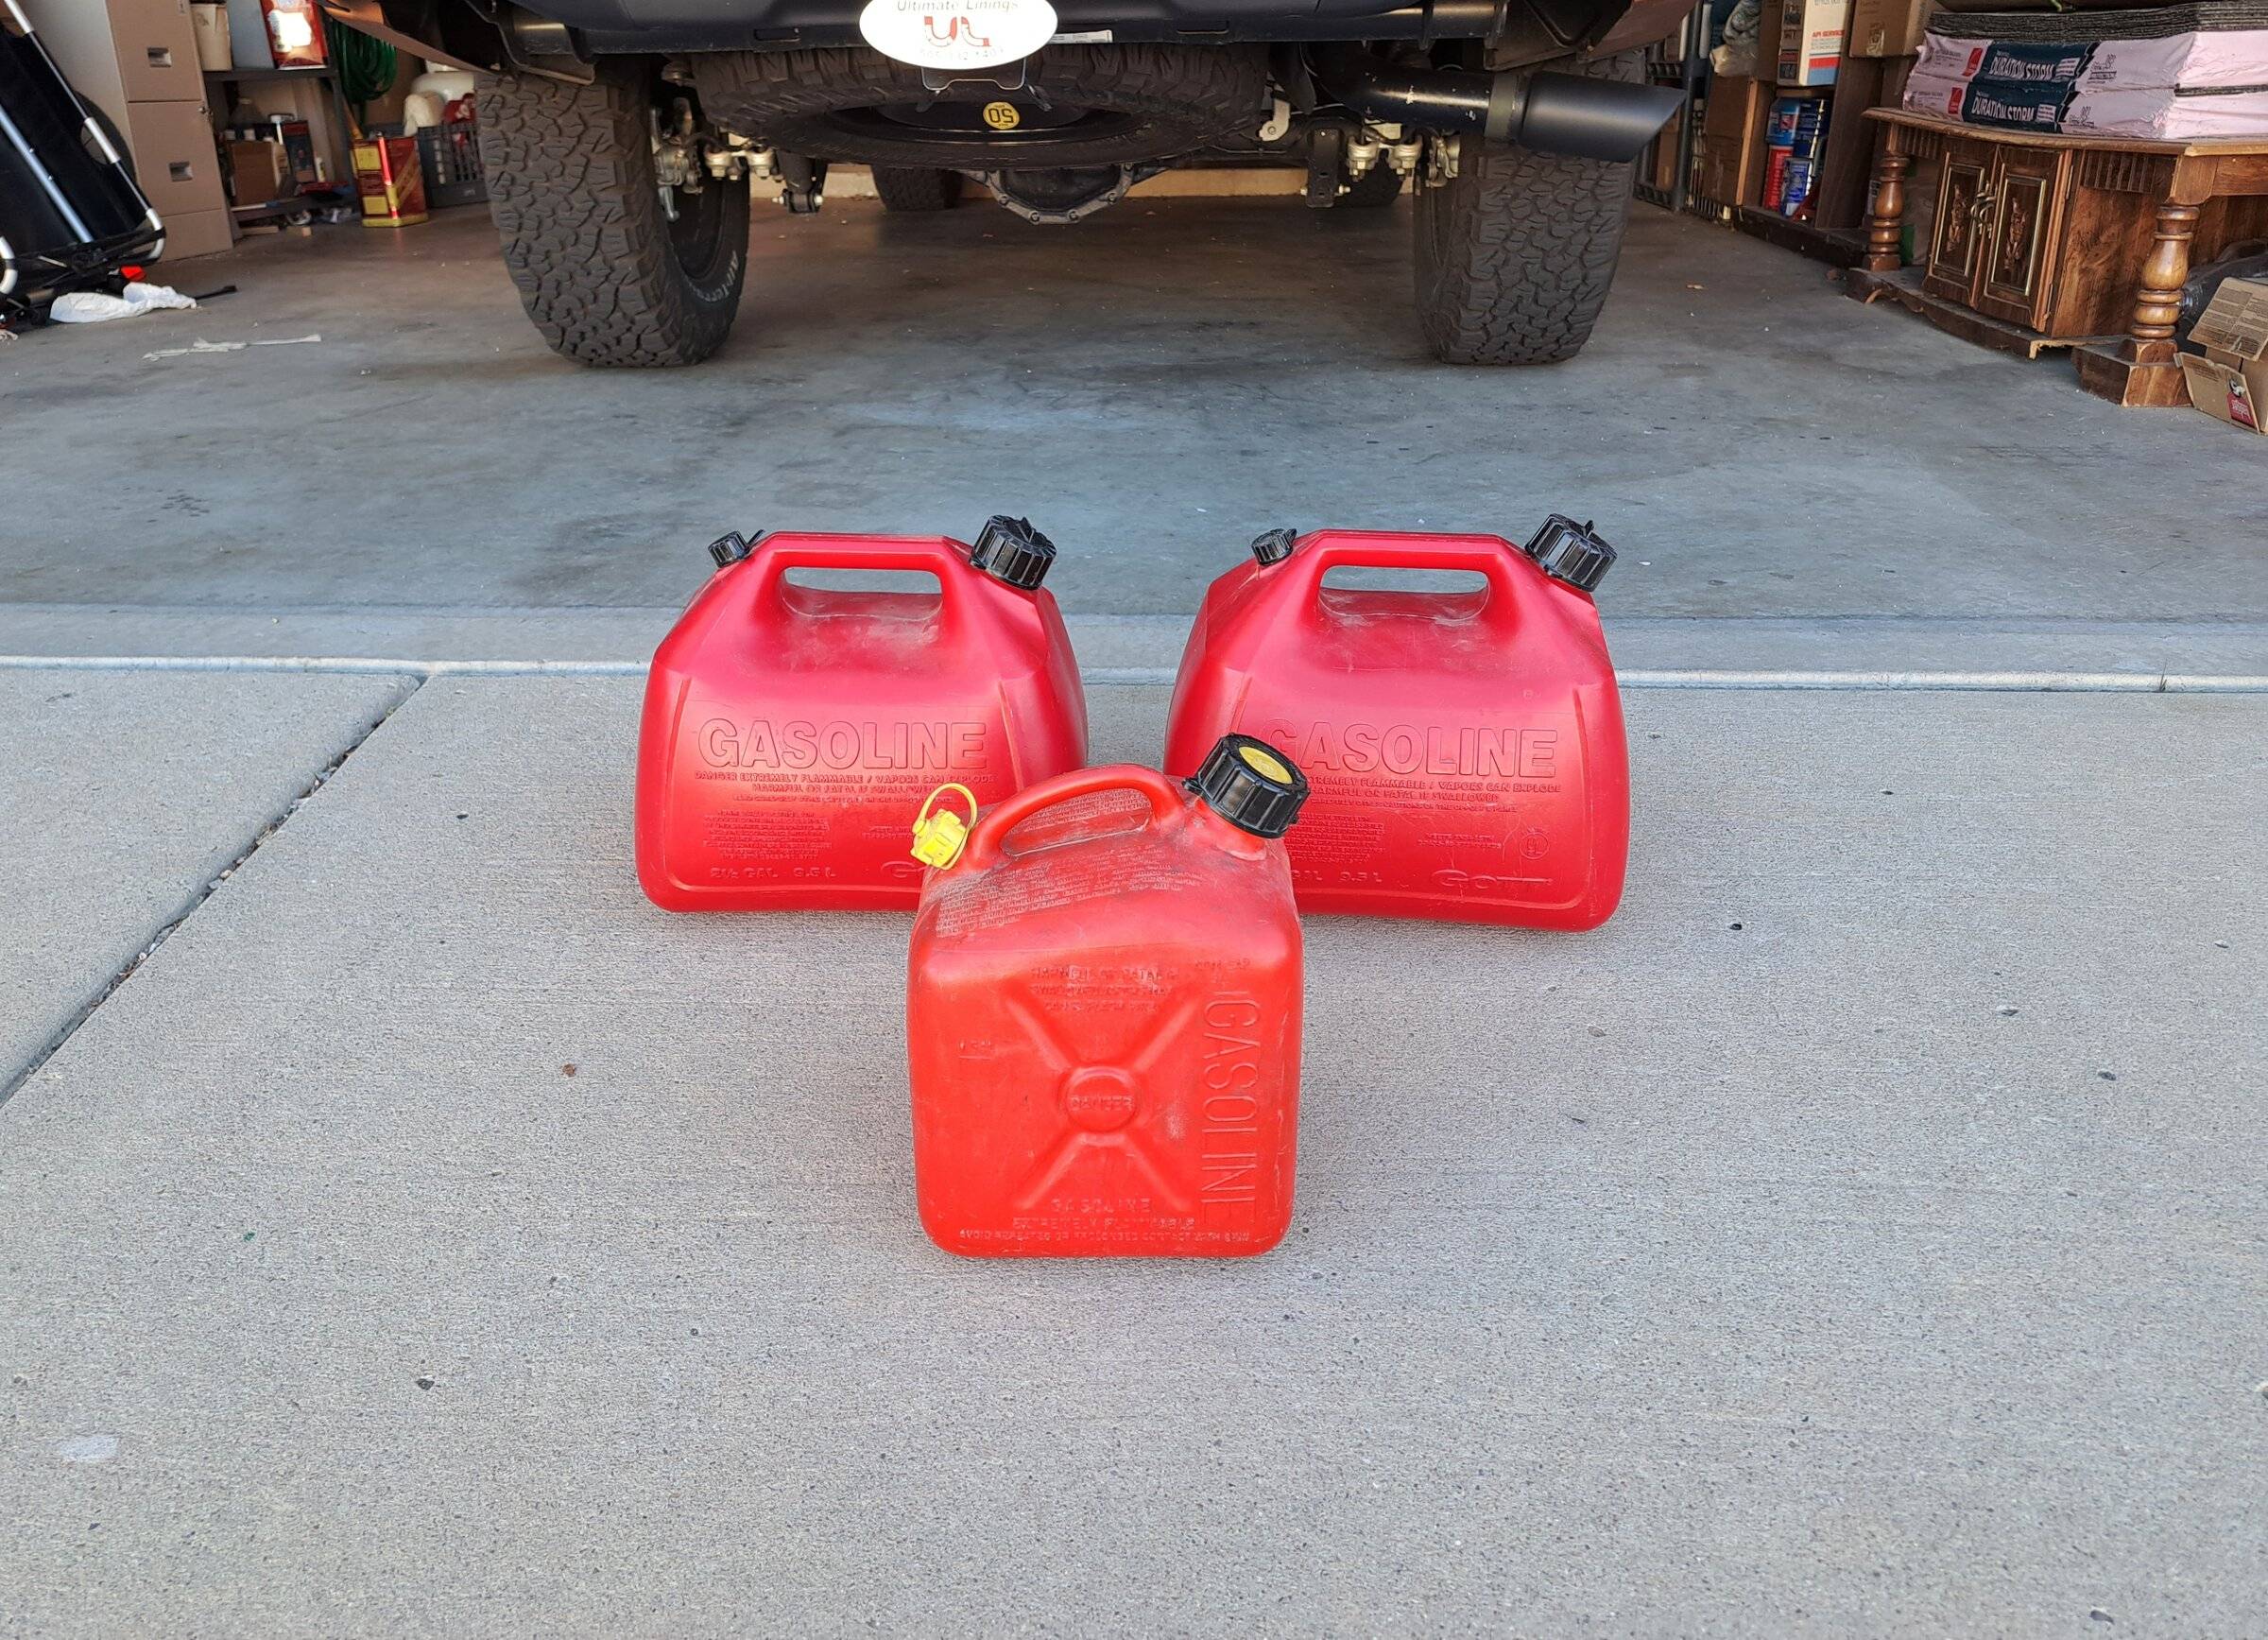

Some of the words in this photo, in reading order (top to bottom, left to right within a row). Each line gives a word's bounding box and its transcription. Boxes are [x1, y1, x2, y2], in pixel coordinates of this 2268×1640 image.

[1988, 56, 2025, 79] DURATION
[2024, 62, 2055, 80] STORM
[1971, 96, 2007, 119] DURATION
[2006, 106, 2035, 122] STORM
[698, 718, 988, 769] GASOLINE
[1261, 718, 1558, 778] GASOLINE
[695, 771, 737, 782] DANGER
[740, 772, 799, 784] EXTREMELY
[801, 774, 864, 785] FLAMMABLE
[875, 774, 919, 785] VAPORS
[922, 775, 944, 785] CAN
[1361, 778, 1426, 790] FLAMMABLE
[1438, 781, 1484, 791] VAPORS
[1486, 783, 1509, 793] CAN
[1513, 783, 1561, 793] EXPLODE
[1202, 998, 1262, 1224] GASOLINE
